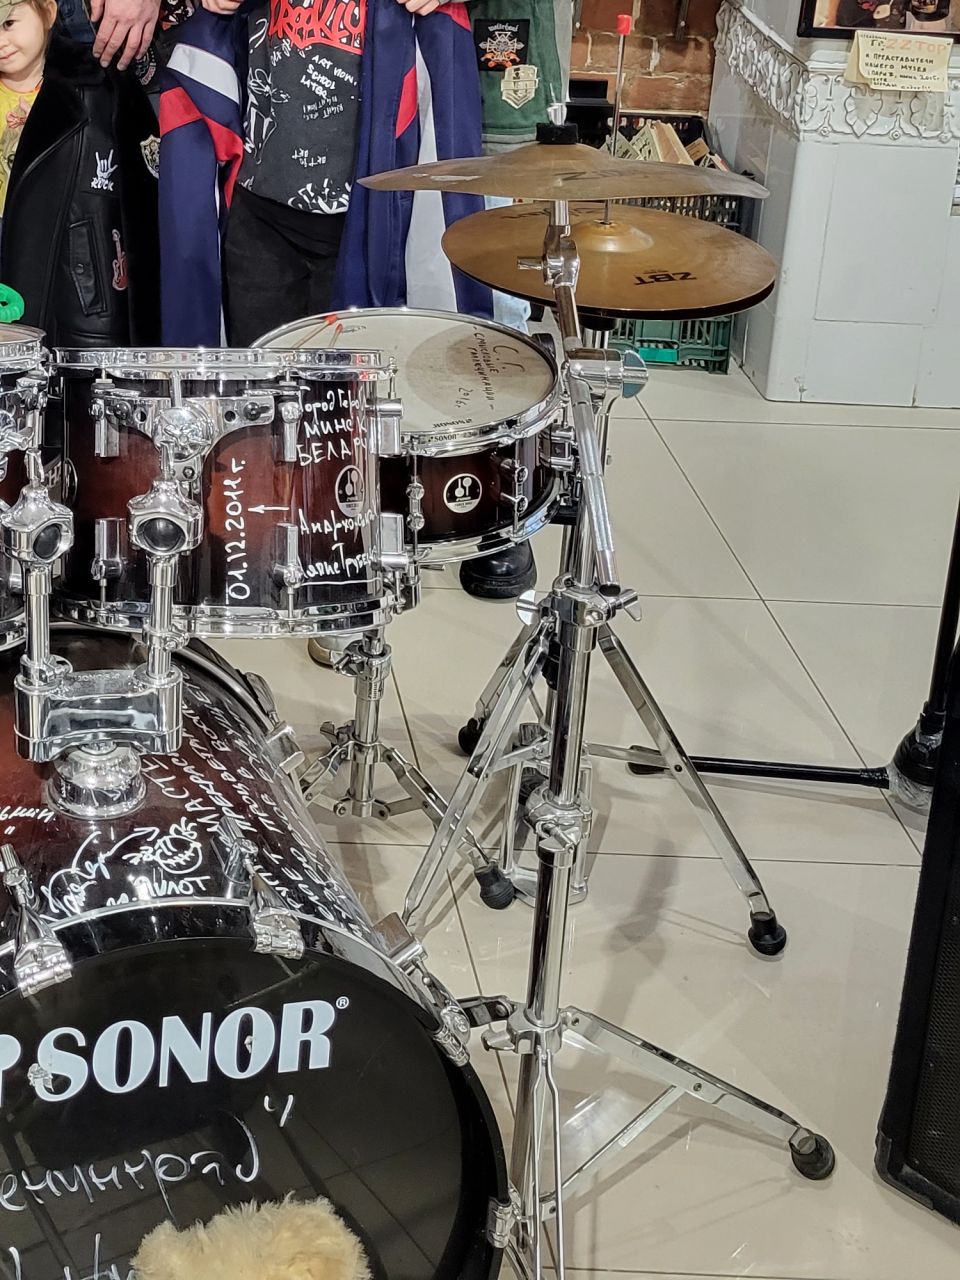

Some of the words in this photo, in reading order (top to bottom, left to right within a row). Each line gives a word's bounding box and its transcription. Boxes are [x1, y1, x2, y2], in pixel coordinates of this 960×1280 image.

[90, 176, 115, 192] ROCK
[634, 271, 697, 286] ZBT
[37, 999, 336, 1103] SONOR
